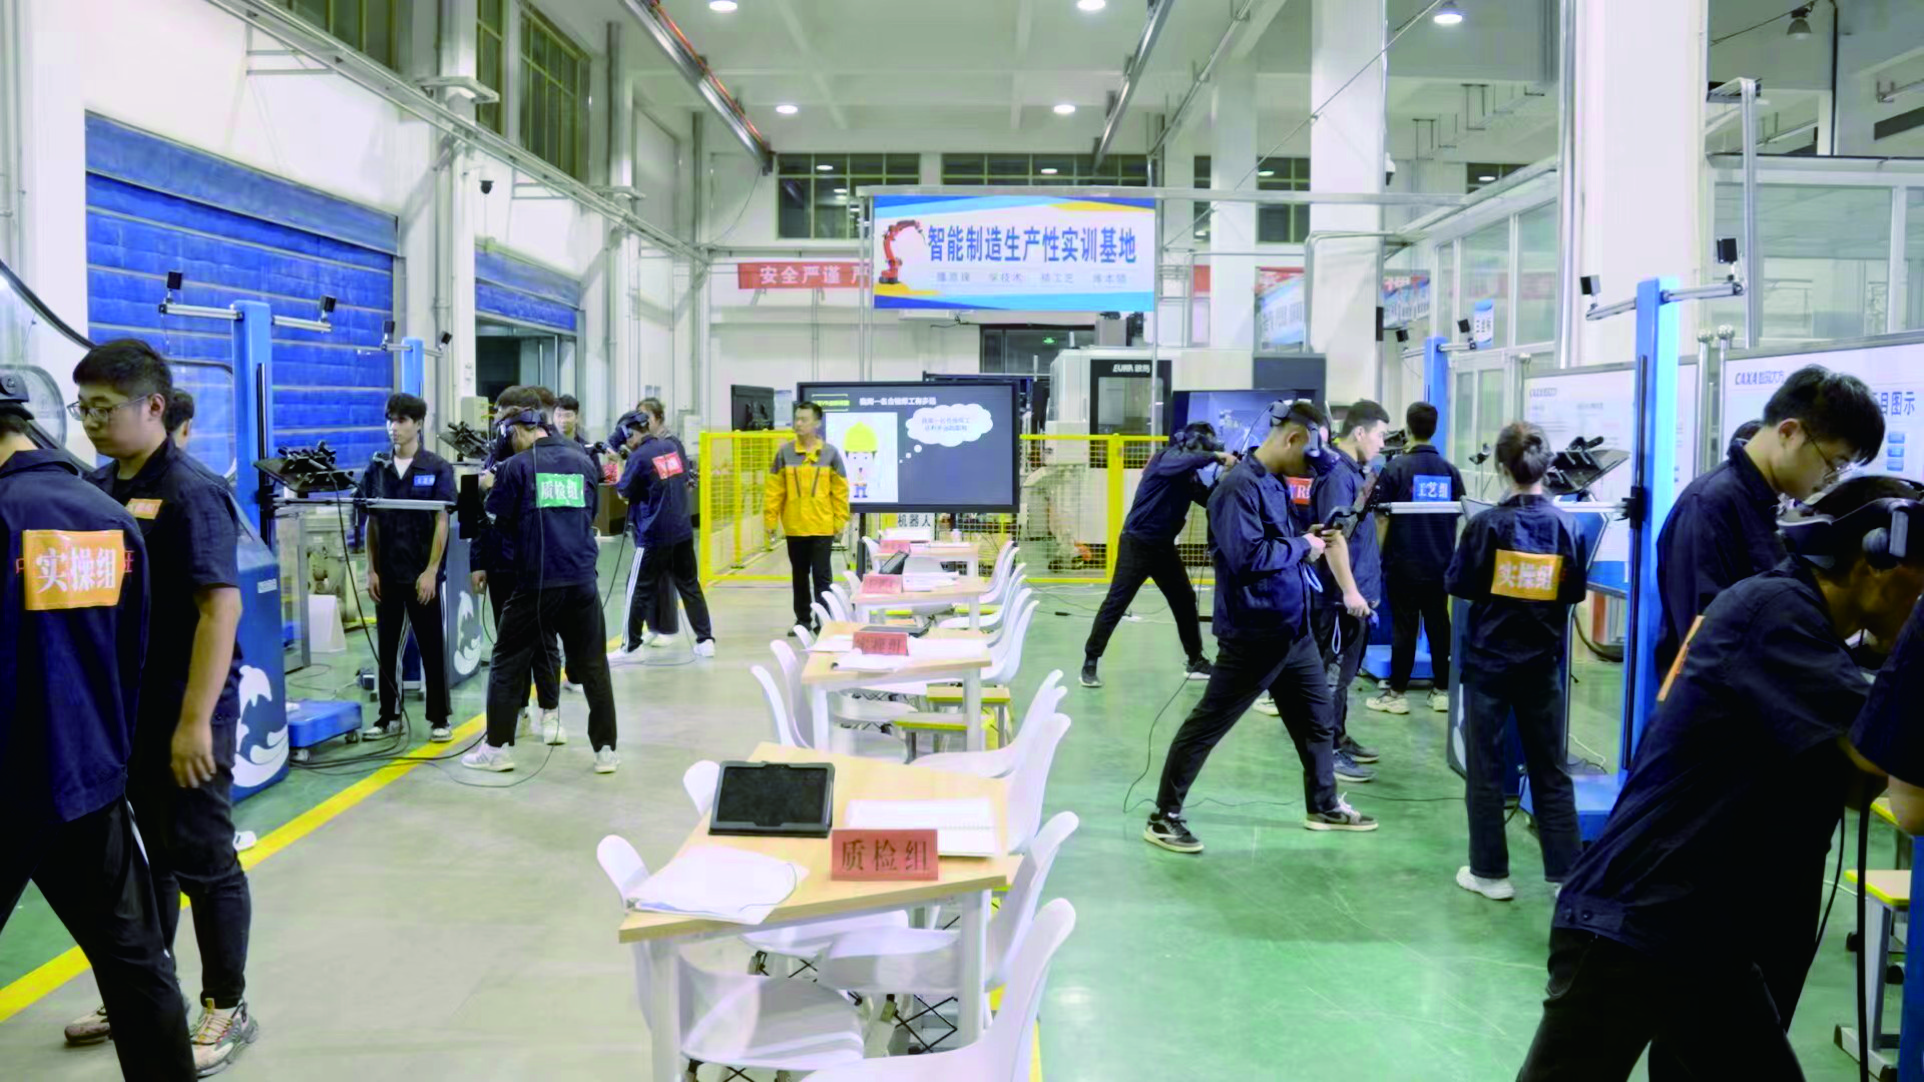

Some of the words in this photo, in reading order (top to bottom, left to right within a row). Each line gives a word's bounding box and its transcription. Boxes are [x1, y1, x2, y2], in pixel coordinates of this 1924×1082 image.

[928, 226, 1136, 263] 智能制造生产性实训基地
[760, 265, 840, 284] 安全严谨
[541, 480, 578, 500] 质检组
[1417, 481, 1448, 498] 工艺组
[898, 514, 930, 527] 机器人
[36, 547, 117, 594] 实操组
[1497, 560, 1554, 590] 实操组
[842, 840, 929, 872] 质检组
